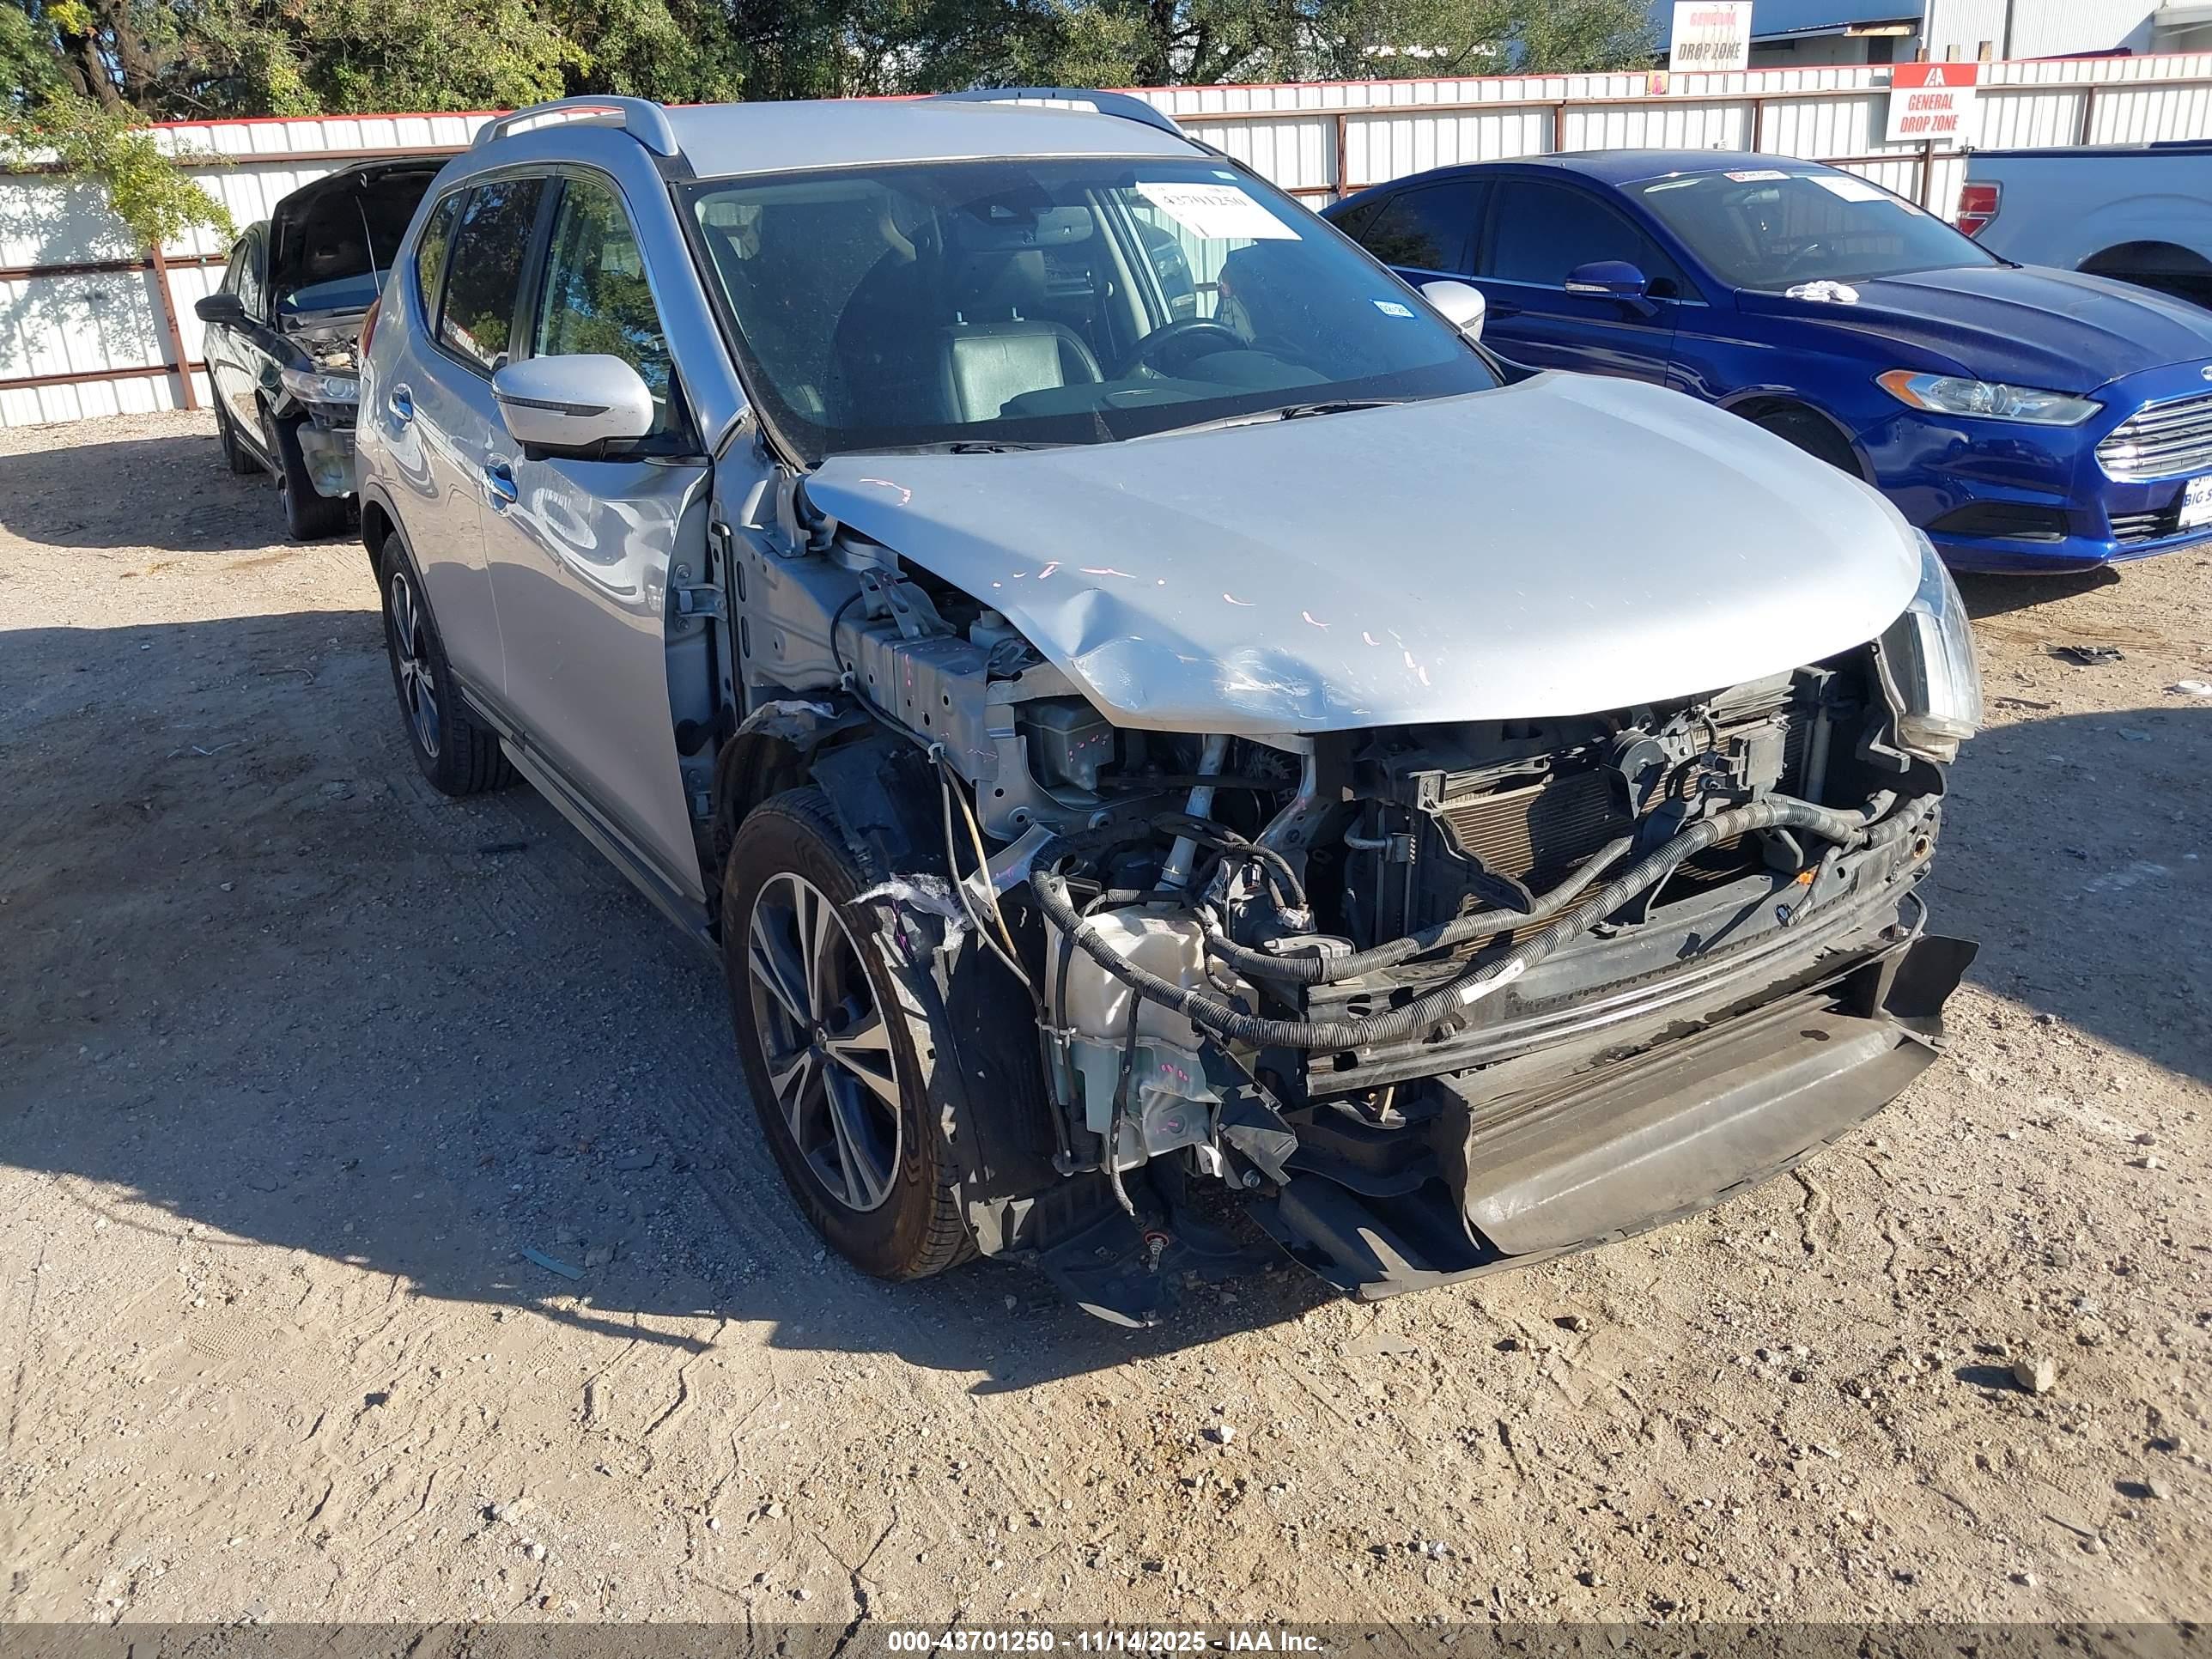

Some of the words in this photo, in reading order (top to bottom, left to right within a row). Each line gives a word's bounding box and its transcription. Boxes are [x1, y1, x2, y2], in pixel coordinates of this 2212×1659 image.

[1677, 43, 1711, 61] DROP
[1711, 42, 1741, 60] ZONE
[1908, 94, 1954, 112] GENERAL
[1899, 115, 1930, 133] DROP
[1930, 114, 1959, 131] ZONE
[2182, 490, 2203, 507] BIG
